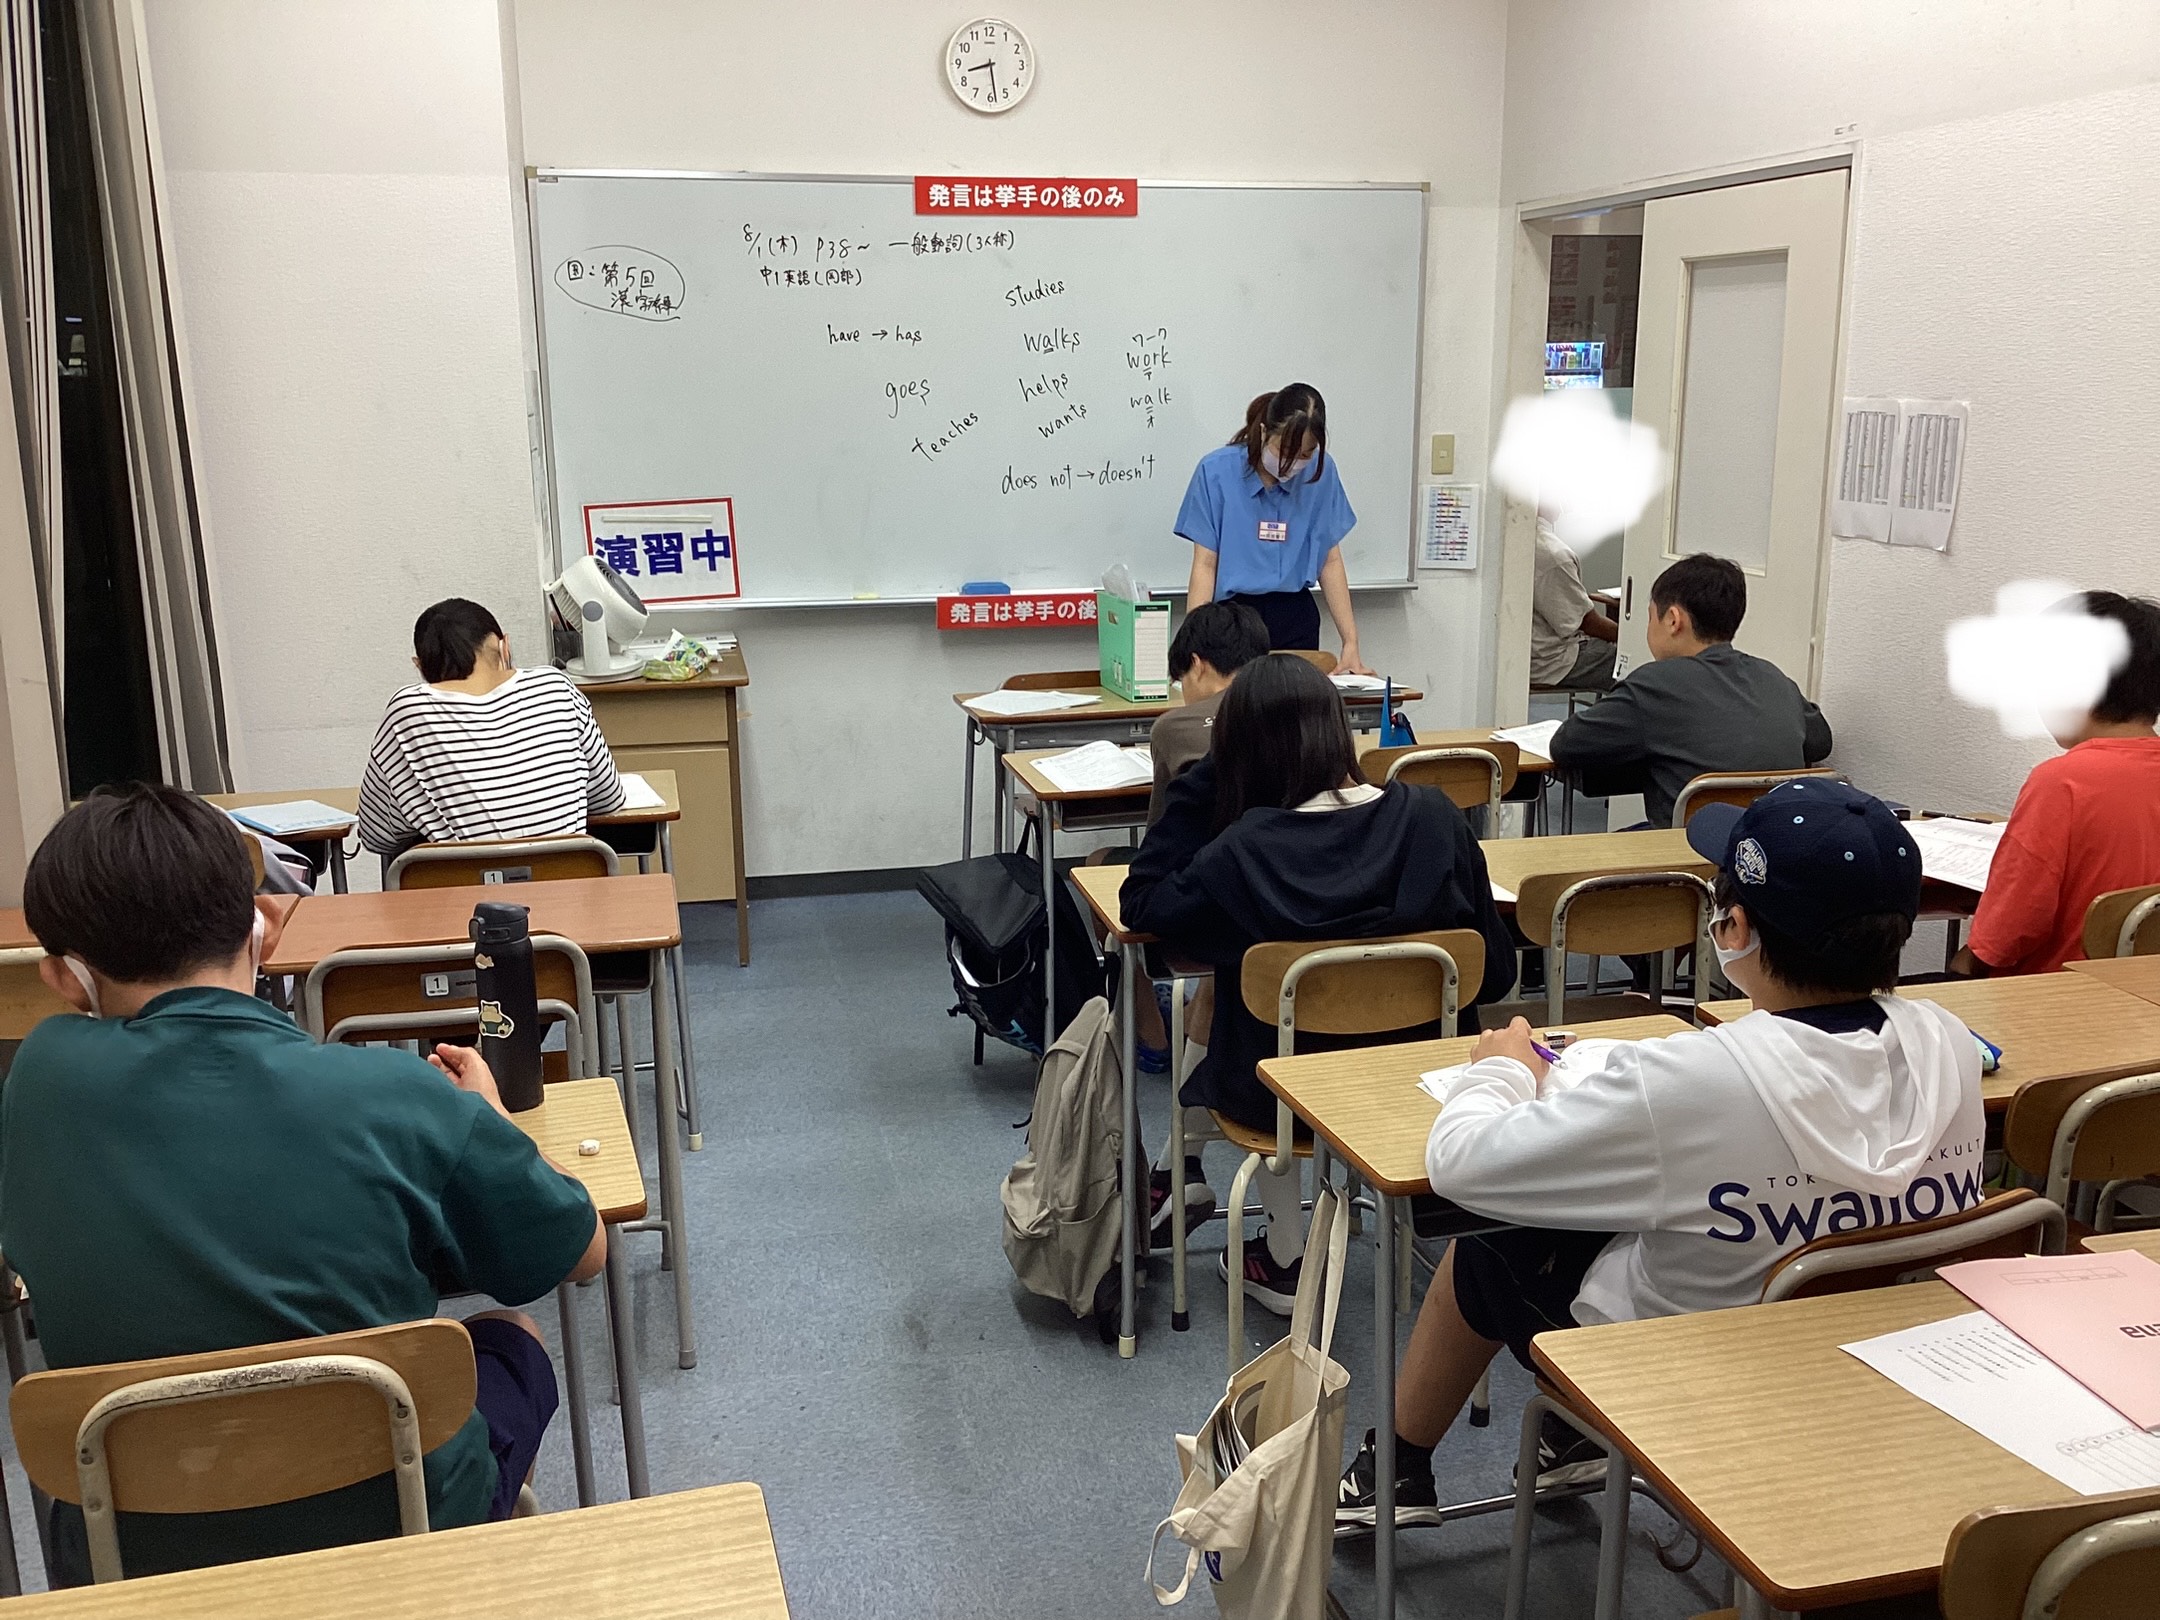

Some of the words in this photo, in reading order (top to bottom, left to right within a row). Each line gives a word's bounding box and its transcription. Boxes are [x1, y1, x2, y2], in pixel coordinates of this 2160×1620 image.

[970, 31, 979, 41] 11
[984, 26, 995, 37] 12
[1003, 32, 1008, 42] 1
[959, 42, 971, 53] 10
[1014, 43, 1020, 55] 2
[955, 58, 962, 69] 9
[1019, 60, 1025, 71] 3
[960, 76, 967, 87] 8
[1012, 77, 1019, 88] 4
[972, 88, 979, 98] 7
[987, 93, 994, 103] 6
[1002, 88, 1009, 99] 5
[928, 183, 1126, 209] 発言は挙手の後のみ
[1004, 278, 1066, 308] studies
[827, 324, 861, 345] have
[895, 325, 923, 347] has
[1023, 327, 1081, 353] walks
[1126, 345, 1172, 369] work
[1018, 372, 1069, 402] helps
[885, 378, 931, 419] goes
[1130, 386, 1172, 409] walk
[1038, 403, 1088, 439] wants
[911, 411, 979, 462] teaches
[1001, 465, 1038, 495] does
[1050, 464, 1073, 490] not
[1099, 453, 1156, 486] doesn't
[594, 528, 732, 577] 演習中
[949, 598, 1098, 624] 発言は挙手の後
[490, 872, 496, 883] 1
[433, 977, 440, 989] 1
[1766, 1173, 1817, 1189] TOK
[1706, 1161, 1984, 1246] Swallow
